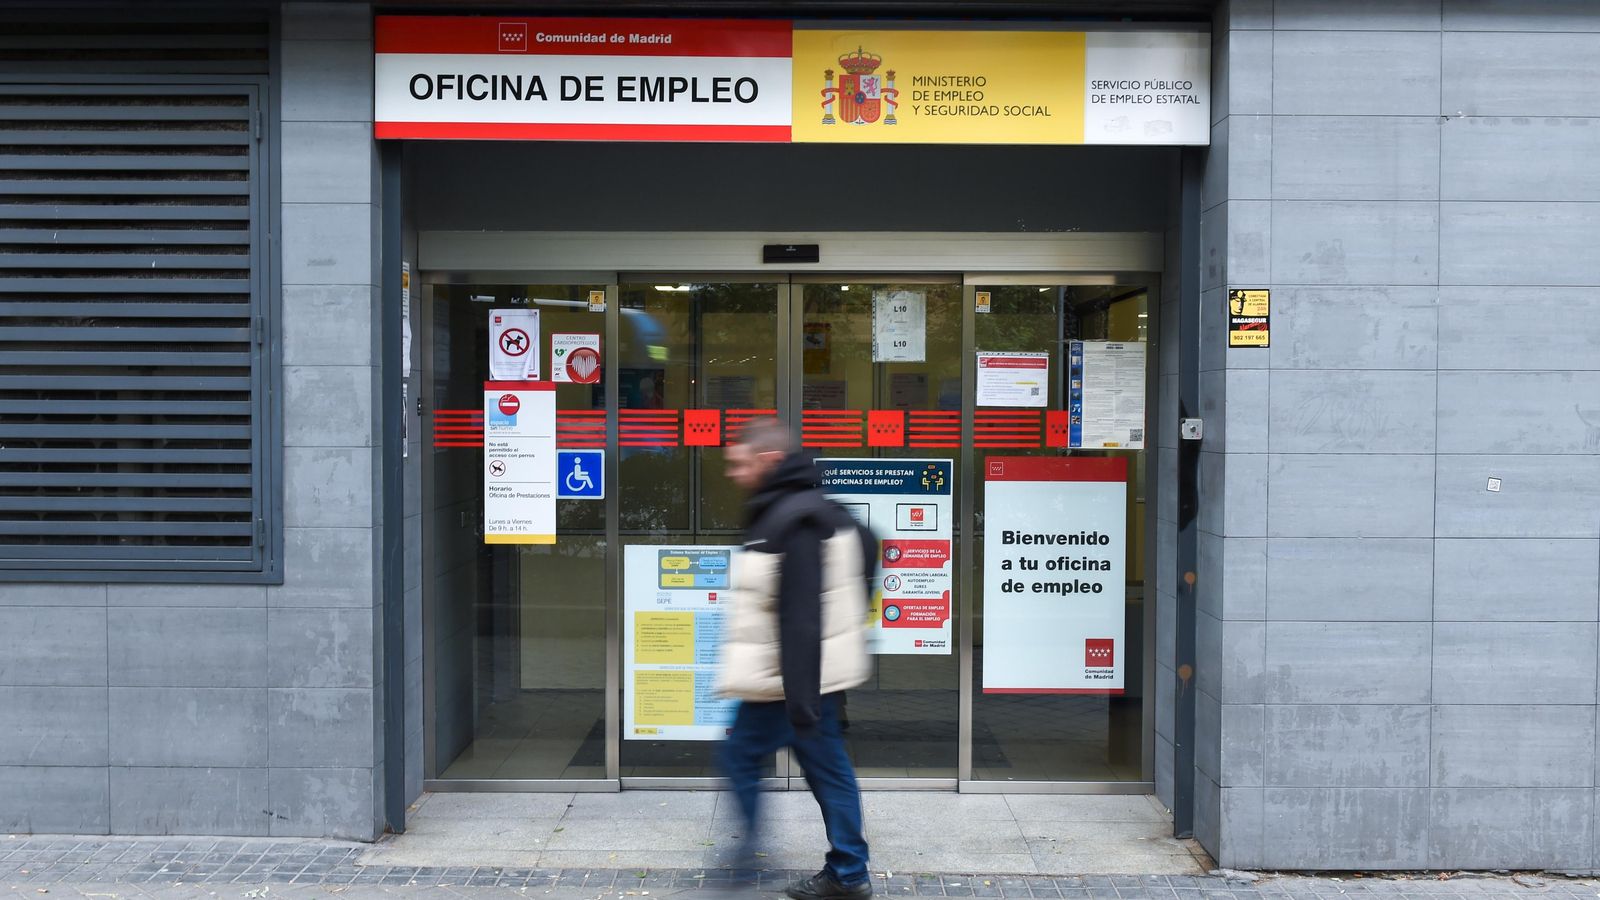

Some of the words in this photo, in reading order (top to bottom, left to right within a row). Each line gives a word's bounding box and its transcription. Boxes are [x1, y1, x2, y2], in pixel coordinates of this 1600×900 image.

[535, 32, 606, 44] Comunidad
[609, 33, 625, 44] de
[628, 33, 672, 44] Madrid
[912, 76, 986, 87] MINISTERIO
[1091, 79, 1141, 91] SERVICIO
[1143, 76, 1193, 91] PÚBLICO
[409, 73, 548, 101] OFICINA
[560, 75, 604, 102] DE
[617, 76, 759, 104] EMPLEO
[912, 91, 931, 101] DE
[933, 90, 985, 102] EMPLEO
[1091, 94, 1106, 104] DE
[1108, 94, 1154, 105] EMPLEO
[1156, 94, 1201, 105] ESTATAL
[912, 105, 921, 116] Y
[923, 105, 1000, 117] SEGURIDAD
[1003, 105, 1052, 118] SOCIAL
[1002, 531, 1110, 545] Bienvenido
[1001, 559, 1012, 571] a
[1019, 556, 1038, 571] tu
[1045, 556, 1111, 571] oficina
[1001, 579, 1025, 593] de
[1031, 579, 1103, 596] empleo
